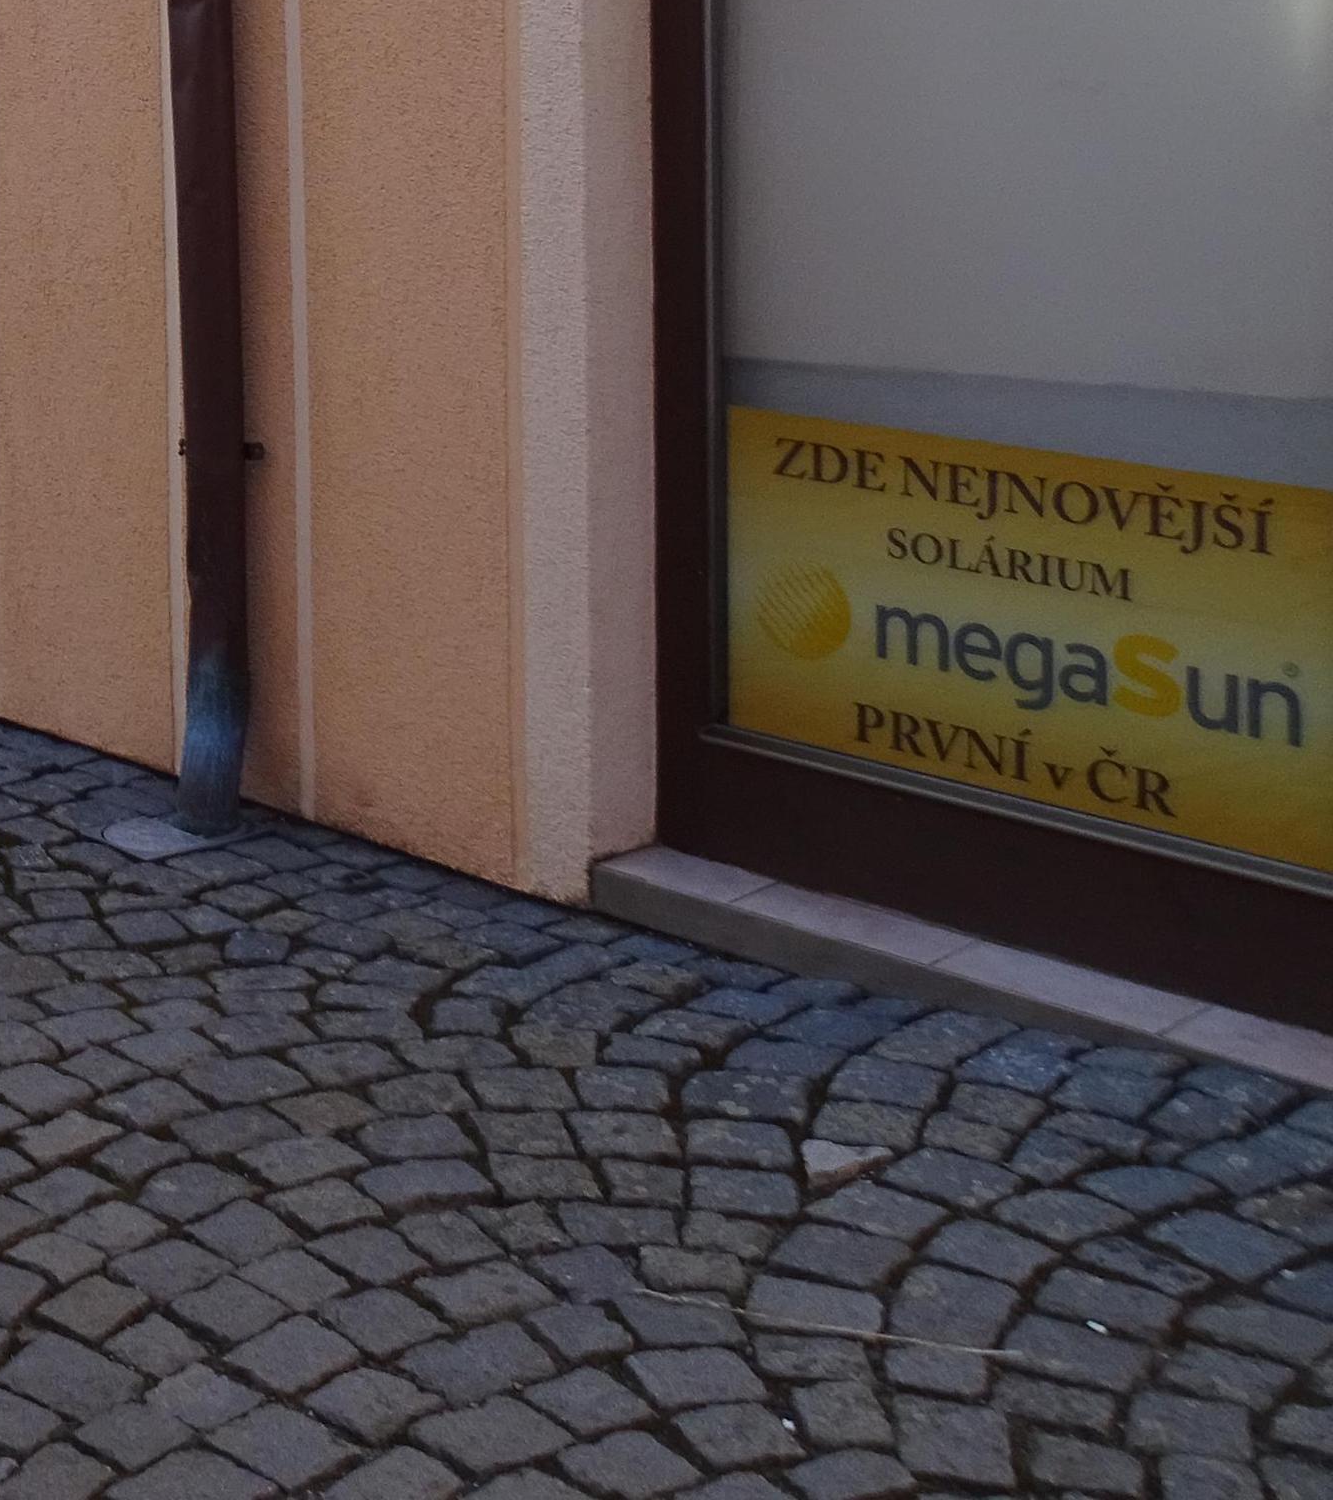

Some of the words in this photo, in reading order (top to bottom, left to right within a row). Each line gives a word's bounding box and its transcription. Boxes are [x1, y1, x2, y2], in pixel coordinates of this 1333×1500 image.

[773, 436, 887, 493] ZDE
[899, 455, 1276, 556] NEJNOVĚJŠÍ
[886, 527, 1133, 602] SOLÁRIUM
[874, 602, 1305, 749] megaSun
[853, 702, 1032, 783] PRVNÍ
[1042, 761, 1076, 790] v
[1086, 746, 1178, 818] ČR
